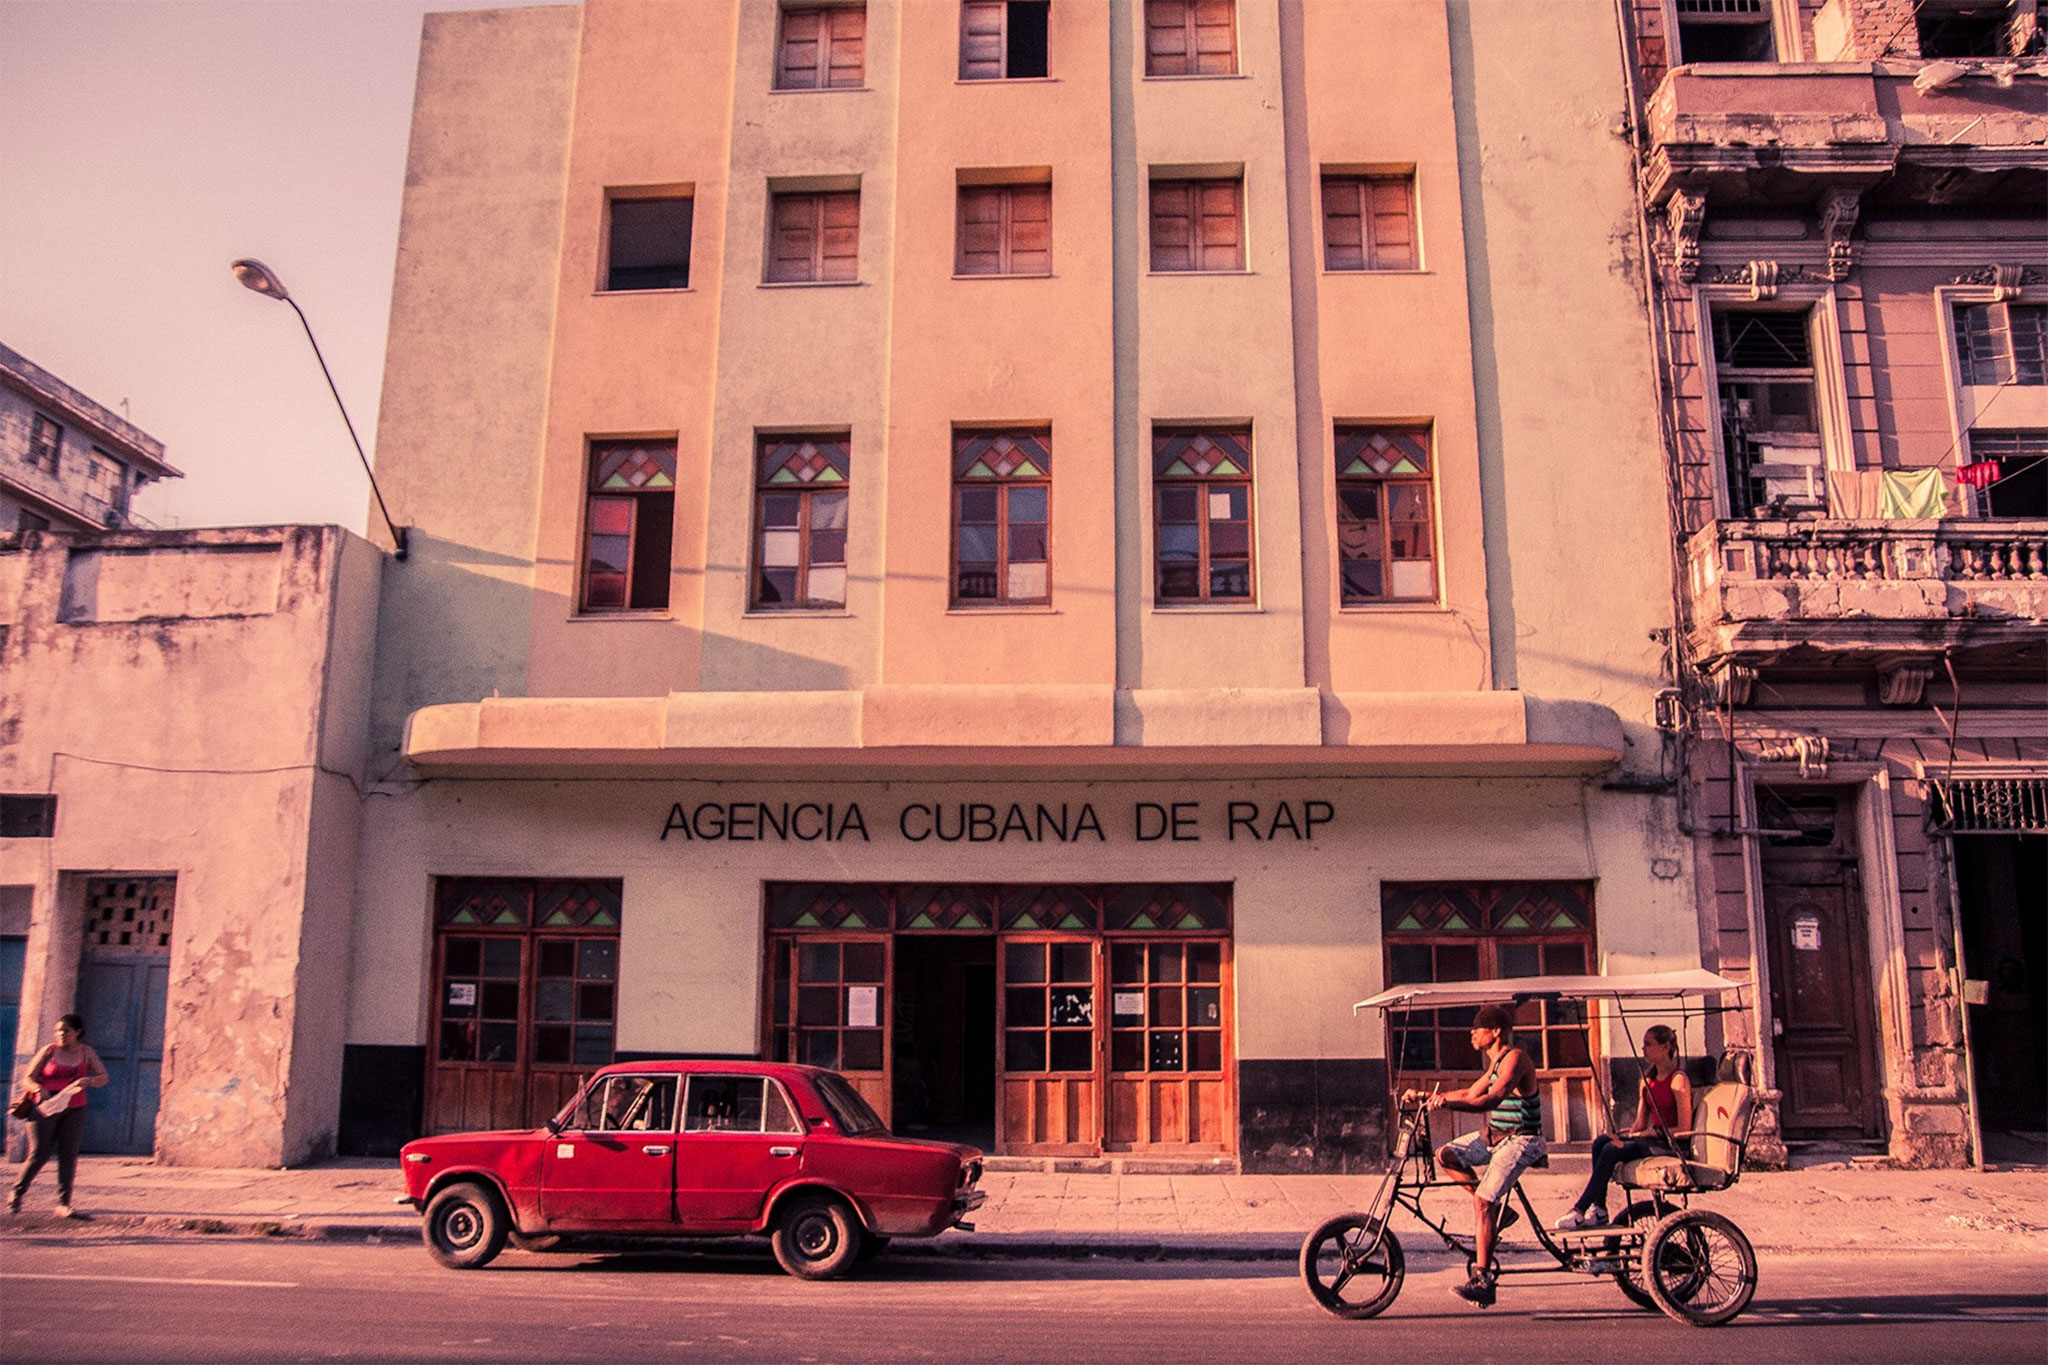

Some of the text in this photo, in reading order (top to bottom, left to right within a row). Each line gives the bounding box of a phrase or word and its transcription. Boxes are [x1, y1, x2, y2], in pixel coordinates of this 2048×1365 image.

[660, 800, 1335, 842] AGENCIA CUBANA DE RAP
